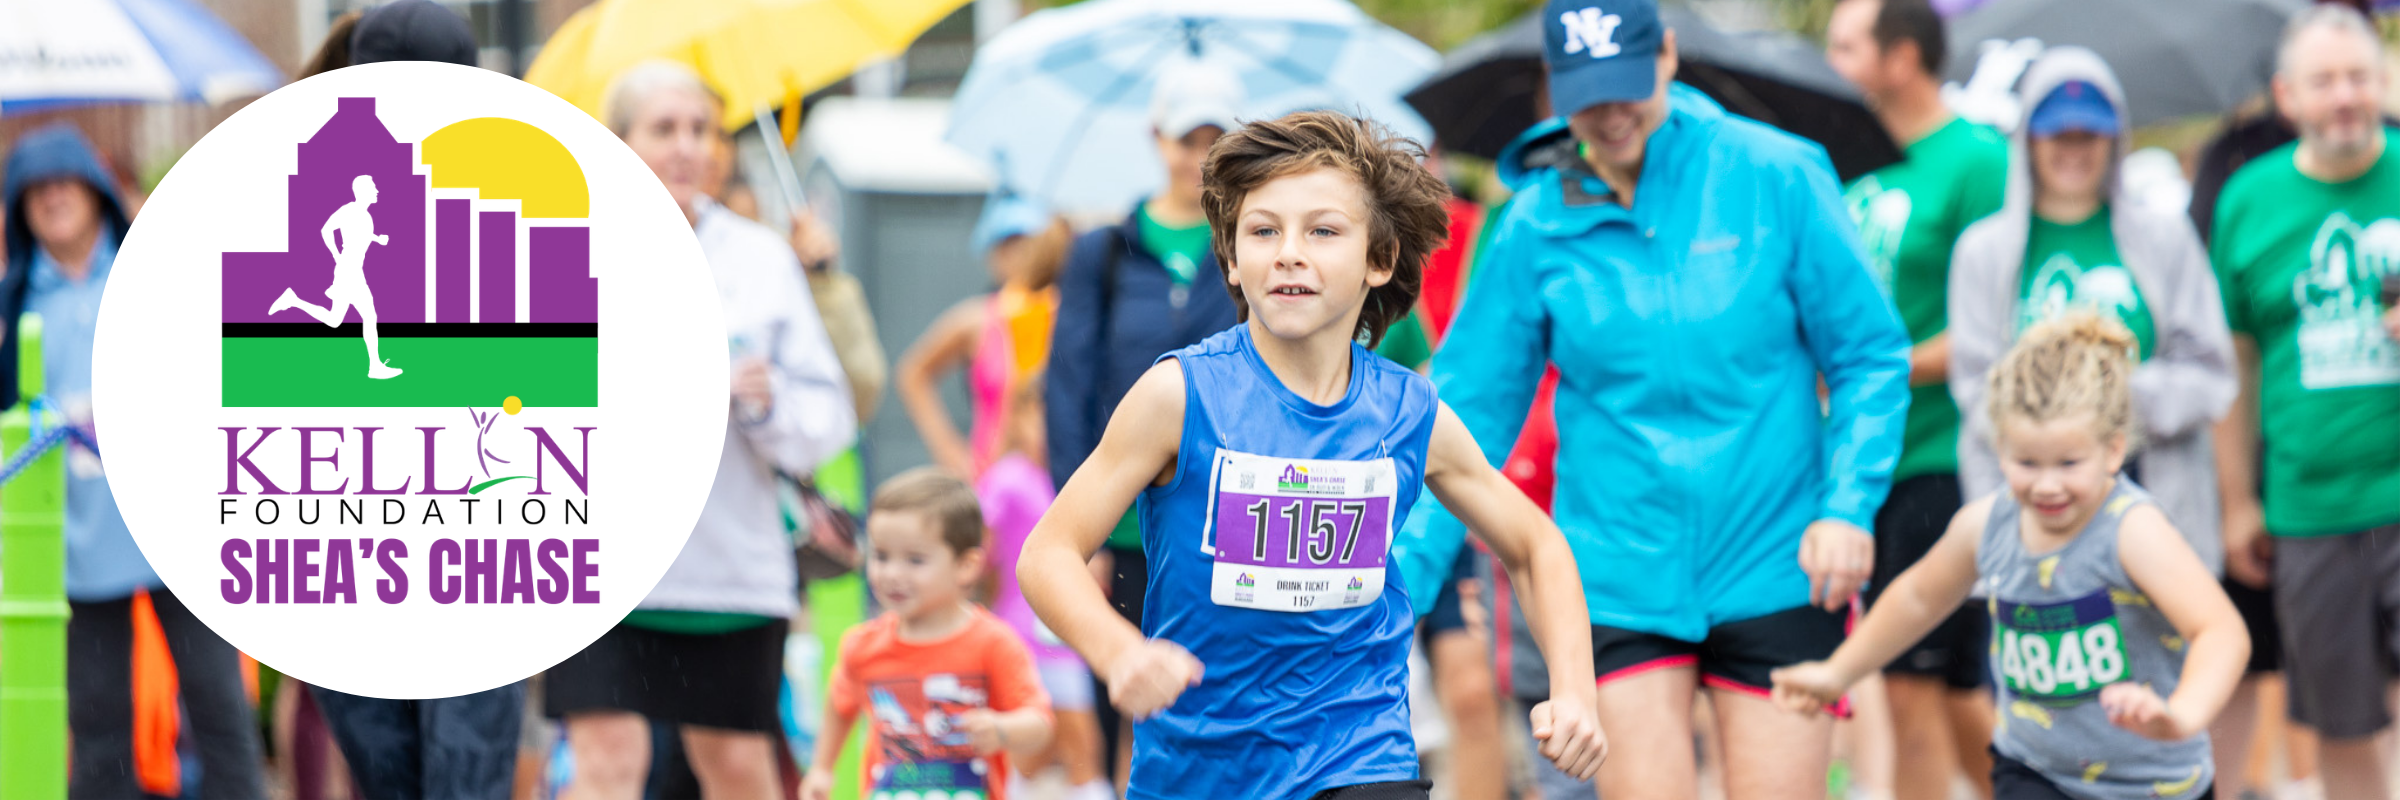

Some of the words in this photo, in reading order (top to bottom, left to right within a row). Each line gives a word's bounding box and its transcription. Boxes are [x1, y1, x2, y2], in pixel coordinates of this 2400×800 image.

[1560, 6, 1622, 59] NY
[1246, 497, 1367, 566] 1157
[1276, 579, 1302, 591] DRINK
[1304, 580, 1330, 592] TICKET
[1292, 595, 1316, 607] 1157
[2003, 622, 2125, 695] 4848
